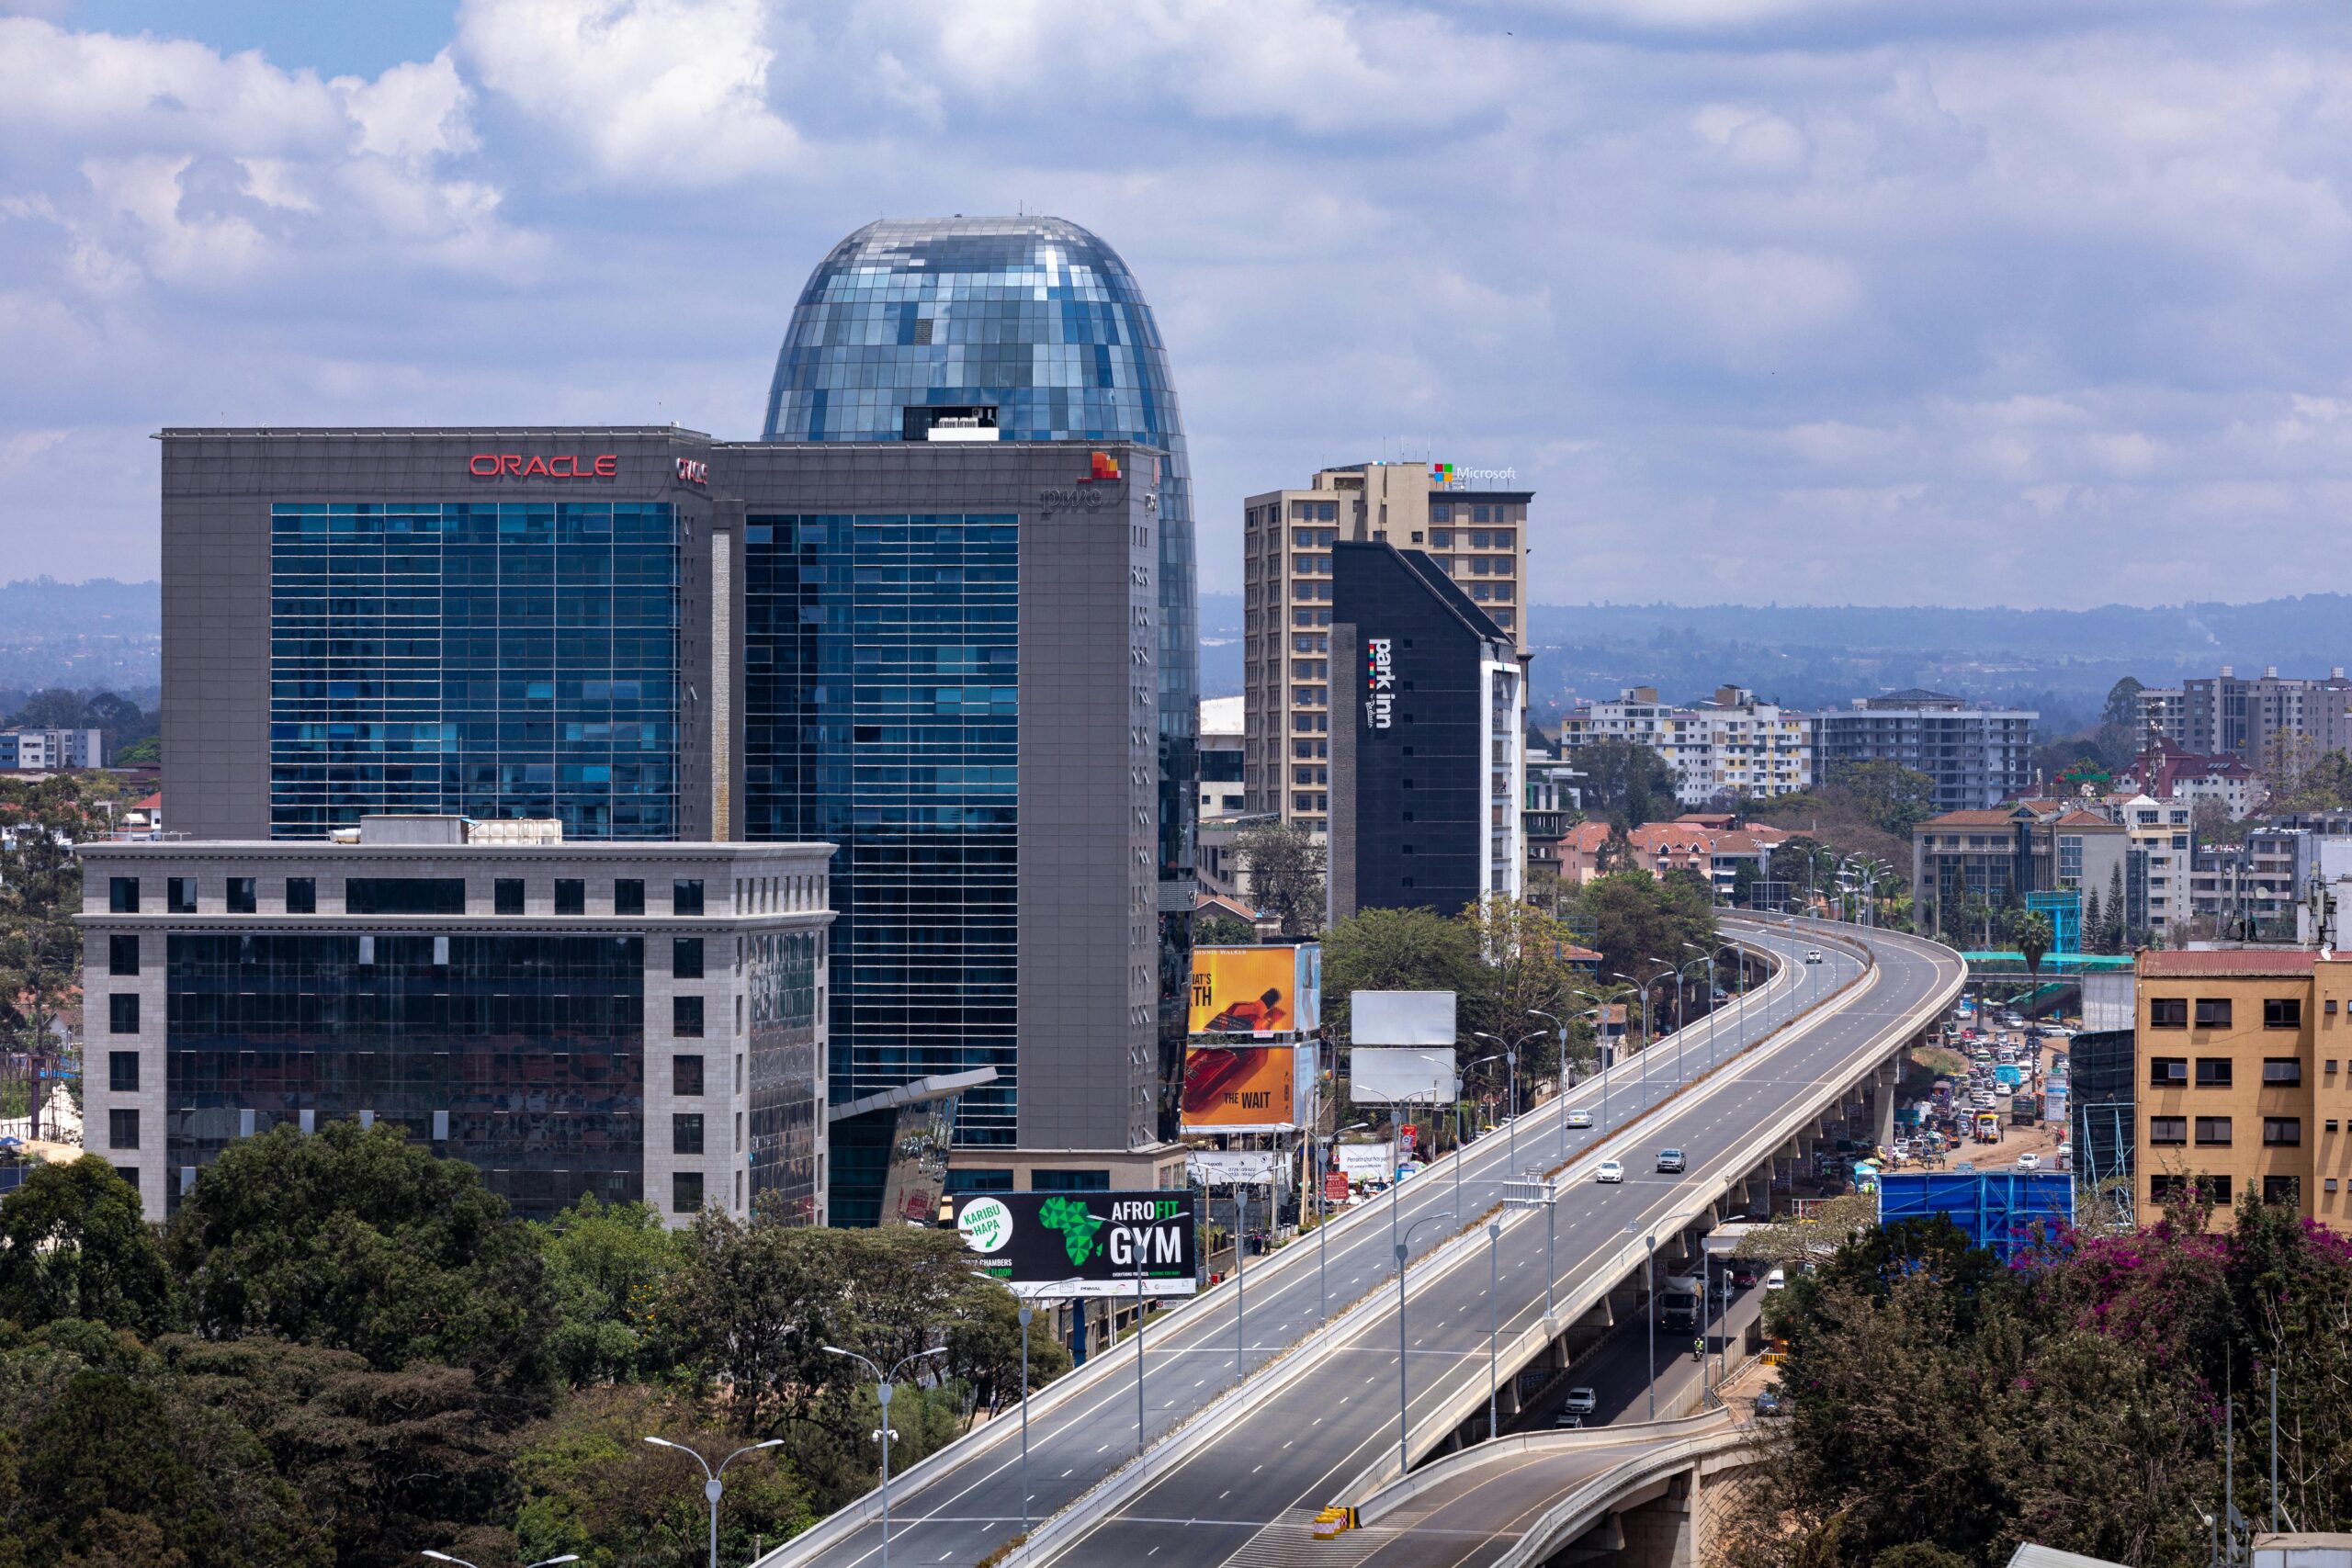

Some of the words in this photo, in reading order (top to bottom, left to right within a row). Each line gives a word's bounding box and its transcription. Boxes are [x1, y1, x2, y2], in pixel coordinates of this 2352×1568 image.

[469, 454, 617, 478] ORACLE
[1456, 467, 1516, 479] Microsoft
[1042, 488, 1102, 513] pwc
[1369, 639, 1396, 690] park
[1375, 694, 1396, 728] inn
[1224, 1093, 1238, 1104] THE
[1242, 1091, 1271, 1109] WAIT
[964, 1204, 1001, 1225] KARIBU
[1112, 1201, 1179, 1221] AFROFIT
[974, 1219, 1001, 1236] HAPA
[1110, 1226, 1182, 1265] GYM
[979, 1258, 1012, 1267] CHAMBERS
[991, 1268, 1012, 1277] FLOOR
